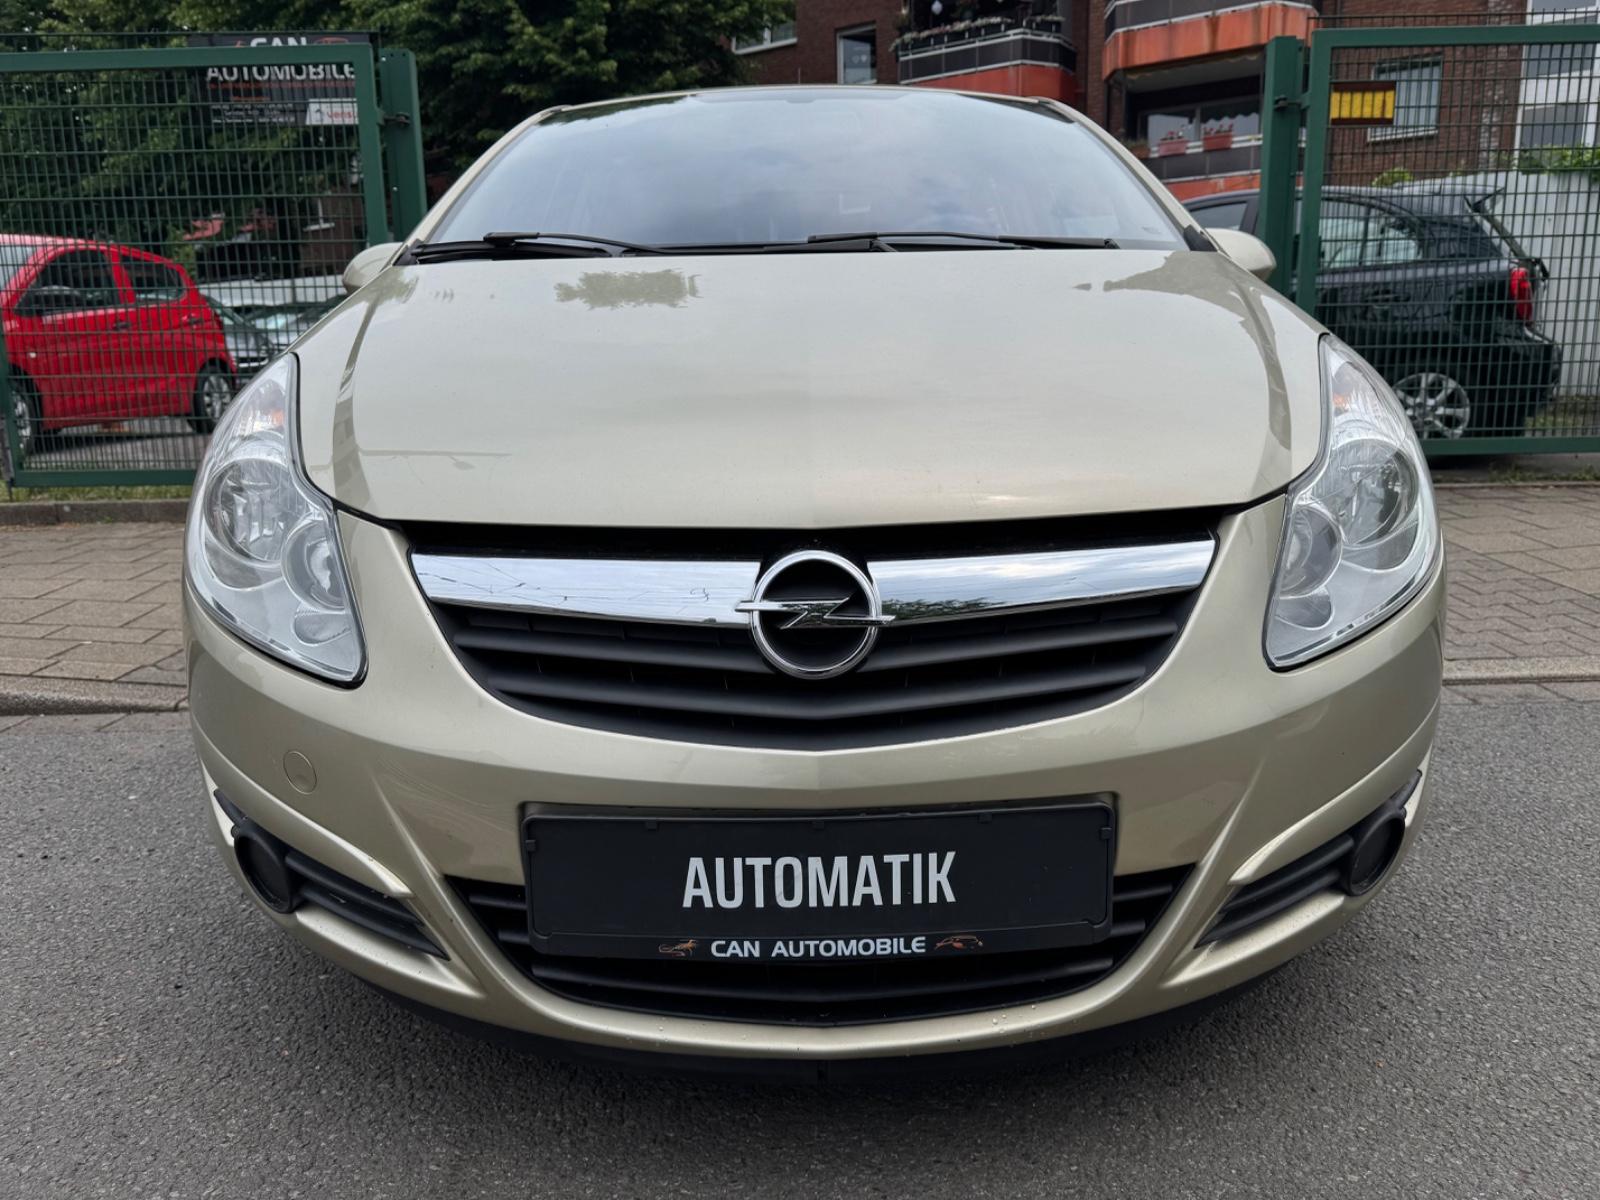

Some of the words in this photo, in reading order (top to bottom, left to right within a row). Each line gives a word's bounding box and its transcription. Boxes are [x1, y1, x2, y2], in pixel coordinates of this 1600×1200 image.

[682, 851, 956, 909] AUTOMATIK
[710, 940, 760, 958] CAN
[771, 936, 926, 958] AUTOMOBILE
